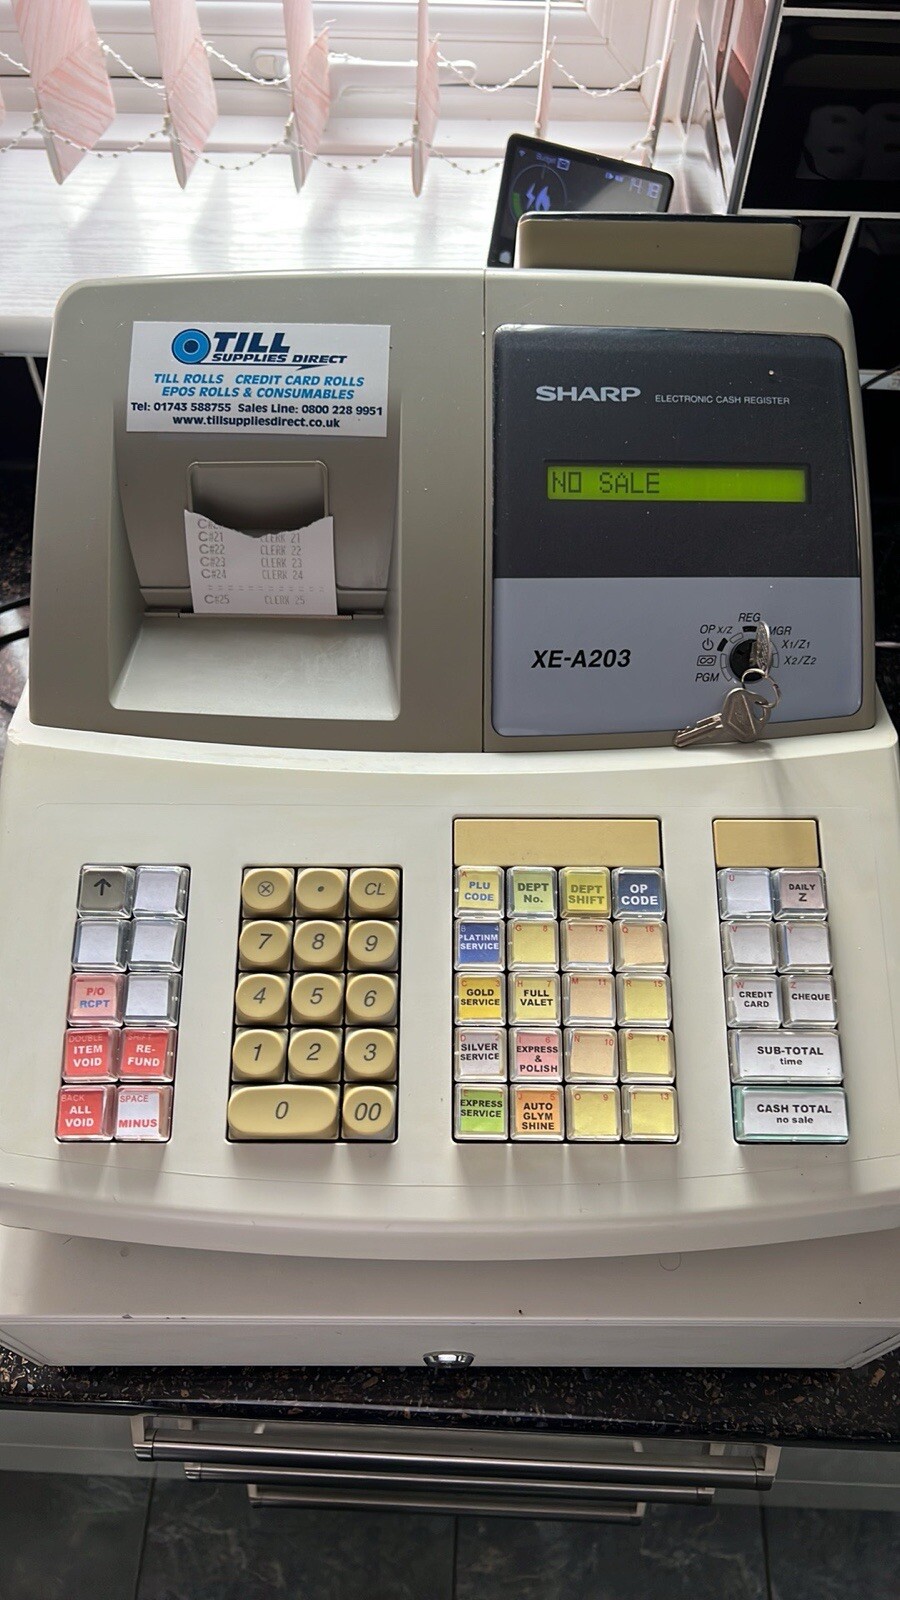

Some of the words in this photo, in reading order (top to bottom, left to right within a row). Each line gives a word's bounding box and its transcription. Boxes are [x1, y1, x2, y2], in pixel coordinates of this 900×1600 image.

[213, 331, 291, 353] TILL
[211, 353, 288, 363] SUPPLIES
[291, 354, 348, 364] DIRECT
[154, 373, 180, 384] TILL
[183, 374, 224, 384] ROLLS
[235, 374, 282, 385] CREDIT
[285, 375, 320, 386] CARD
[323, 376, 365, 387] ROLLS
[161, 386, 195, 397] EPOS
[199, 387, 240, 398] ROLLS
[243, 388, 252, 398] &
[256, 388, 355, 400] CONSUMABLES
[536, 385, 641, 402] SHARP
[655, 395, 713, 404] ELECTRONIC
[715, 395, 741, 404] CASH
[744, 396, 790, 405] REGISTER
[131, 402, 151, 412] Tel:
[153, 402, 188, 412] 01743
[190, 402, 232, 412] 588755
[238, 403, 268, 413] Sales
[271, 403, 299, 414] Line:
[301, 404, 330, 415] 0800
[332, 405, 353, 415] 228
[356, 406, 383, 416] 9951
[172, 415, 340, 429] www.tillsuppliesdirect.co.uk
[552, 471, 582, 493] NO
[599, 472, 660, 494] SALE
[290, 533, 301, 543] 21
[260, 545, 286, 555] CLERK
[291, 546, 302, 556] 22
[261, 558, 287, 568] CLERK
[292, 558, 302, 568] 23
[262, 570, 287, 580] CLERK
[292, 570, 303, 580] 24
[264, 595, 290, 605] CLERK
[294, 595, 306, 605] 25
[738, 613, 761, 622] REG
[700, 625, 716, 634] OP
[717, 626, 733, 634] X/Z
[531, 649, 631, 668] XE-A203
[695, 673, 720, 682] PGM
[364, 882, 386, 896] CL
[469, 881, 490, 890] PLU
[517, 883, 549, 891] DEPT
[570, 884, 602, 894] DEPT
[629, 884, 648, 894] OP
[789, 883, 815, 891] DAILY
[464, 893, 494, 901] CODE
[523, 894, 543, 903] No.
[568, 895, 604, 904] SHIFT
[621, 896, 658, 905] CODE
[798, 893, 807, 902] Z
[258, 933, 272, 949] 7
[311, 933, 325, 950] 8
[365, 935, 378, 951] 9
[86, 987, 105, 996] P/O
[253, 987, 266, 1004] 4
[309, 987, 324, 1004] 5
[466, 989, 494, 997] GOLD
[523, 989, 550, 997] FULL
[739, 991, 773, 999] CREDIT
[363, 990, 377, 1007] 6
[791, 993, 831, 1001] CHEQUE
[80, 1000, 110, 1008] RCPT
[460, 998, 500, 1006] SERVICE
[520, 998, 554, 1006] VALET
[74, 1045, 103, 1054] ITEM
[136, 1044, 156, 1053] RE-
[461, 1043, 498, 1051] SILVER
[757, 1046, 824, 1055] SUB-TOTAL
[253, 1044, 263, 1061] 1
[306, 1043, 321, 1061] 2
[363, 1044, 377, 1061] 3
[460, 1053, 499, 1061] SERVICE
[534, 1055, 542, 1063] &
[780, 1057, 802, 1066] time
[73, 1058, 102, 1067] VOID
[127, 1057, 160, 1067] FUND
[519, 1064, 558, 1073] POLISH
[61, 1094, 85, 1102] BACK
[119, 1095, 148, 1103] SPACE
[460, 1099, 503, 1107] EXPRESS
[523, 1102, 553, 1110] AUTO
[69, 1105, 91, 1114] ALL
[275, 1101, 288, 1119] 0
[354, 1103, 381, 1121] 00
[757, 1104, 789, 1113] CASH
[791, 1104, 832, 1113] TOTAL
[460, 1109, 501, 1118] SERVICE
[523, 1112, 553, 1120] GLYM
[65, 1118, 94, 1127] VOID
[118, 1119, 158, 1128] MINUS
[792, 1116, 814, 1124] sale
[521, 1122, 554, 1130] SHINE
